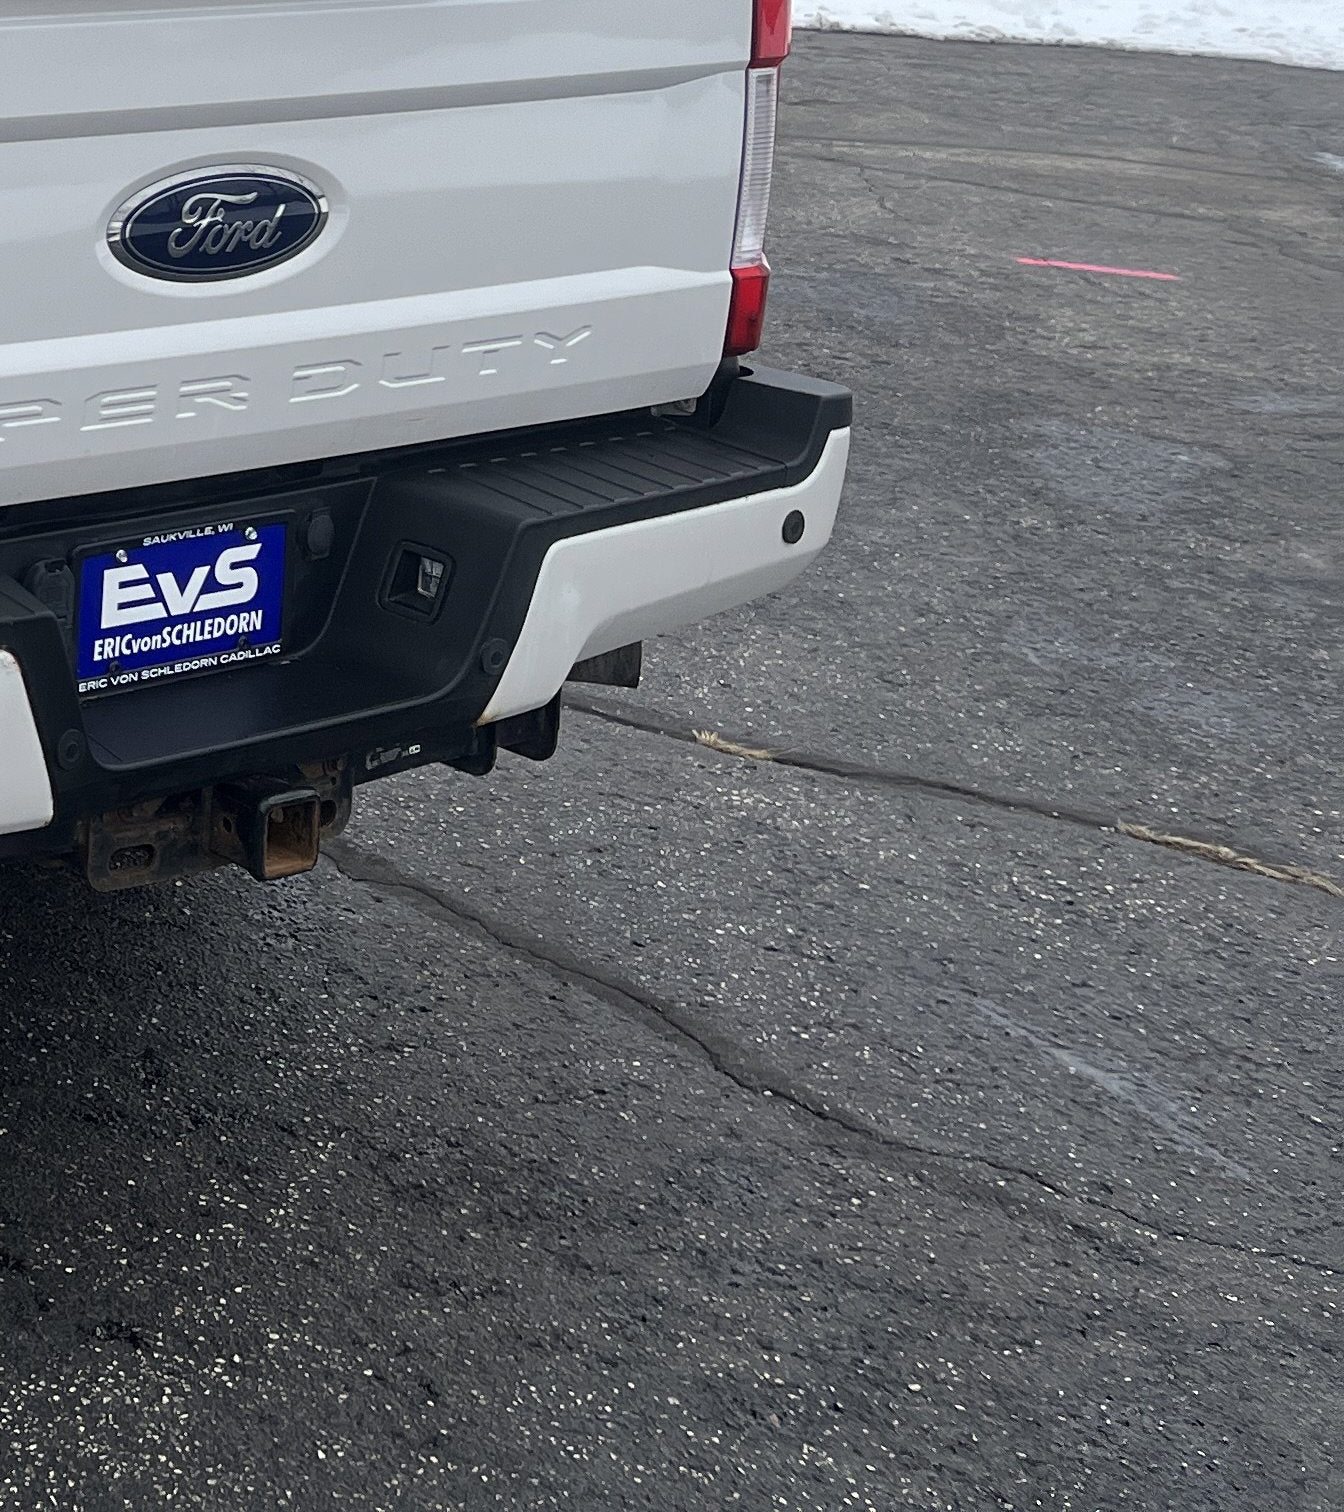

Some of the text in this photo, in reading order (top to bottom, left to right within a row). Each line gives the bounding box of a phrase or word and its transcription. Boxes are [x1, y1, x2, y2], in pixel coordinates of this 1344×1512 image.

[167, 191, 287, 259] Ford
[288, 324, 593, 403] DUTY
[217, 522, 234, 533] WI
[93, 609, 263, 662] ERICvonSCHLEDORN
[78, 644, 281, 693] ERIC VON SCHLEDORN CADILLAC
